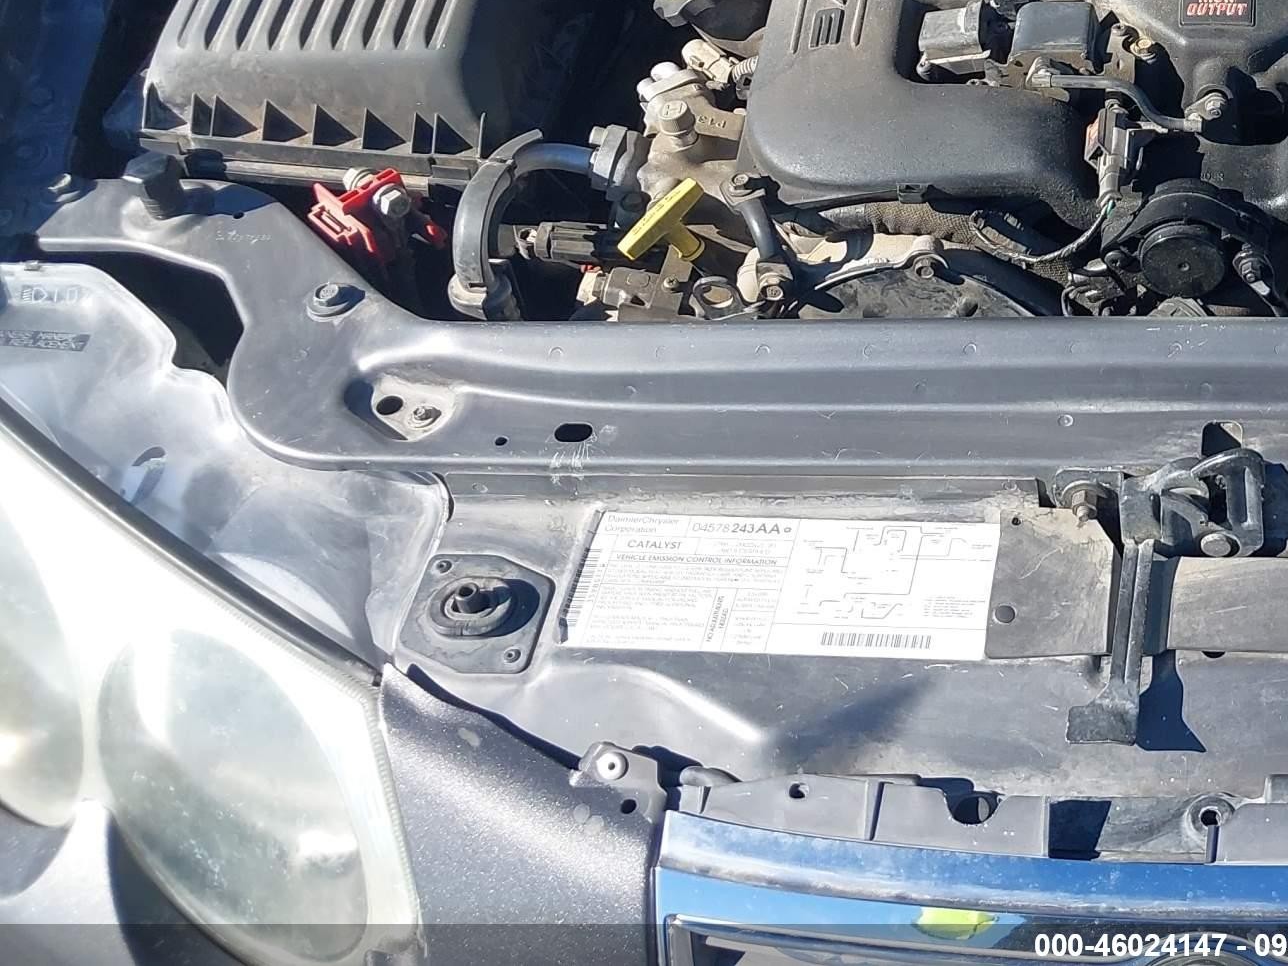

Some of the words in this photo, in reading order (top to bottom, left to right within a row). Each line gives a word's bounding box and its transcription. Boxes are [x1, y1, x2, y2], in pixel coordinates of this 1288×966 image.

[1186, 2, 1248, 16] OUTPUT
[627, 539, 682, 550] CATALYST
[616, 553, 647, 562] VEHICLE
[648, 554, 684, 563] EMISSION
[686, 555, 722, 564] CONTROL
[725, 556, 777, 565] INFORMATION
